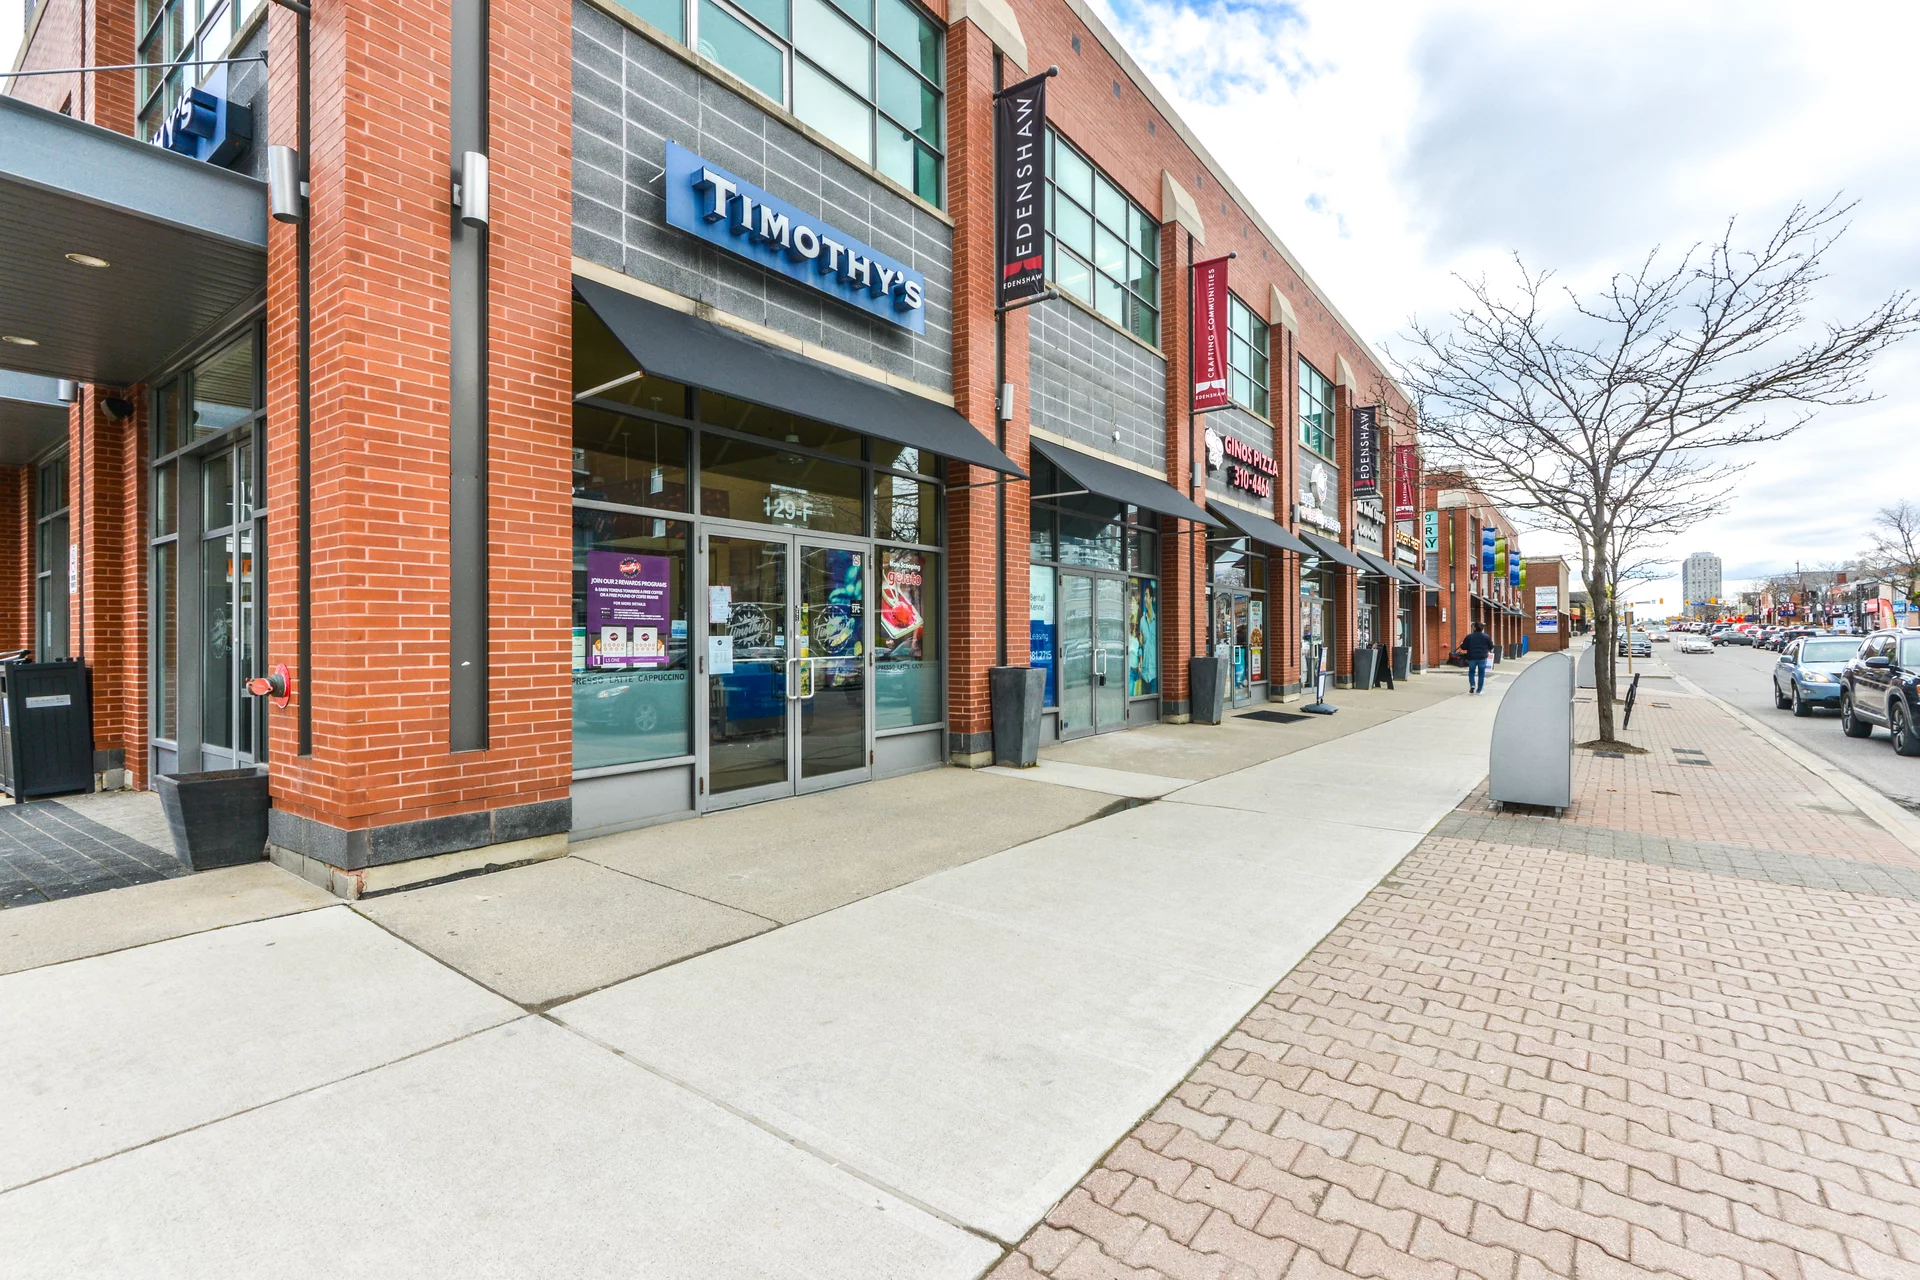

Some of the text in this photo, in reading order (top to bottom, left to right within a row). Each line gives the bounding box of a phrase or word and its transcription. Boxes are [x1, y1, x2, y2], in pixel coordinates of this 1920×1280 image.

[1016, 98, 1033, 256] EDENSHAW
[700, 165, 922, 310] TIMOTHY'S
[1003, 273, 1042, 290] EDENSHAW
[1195, 391, 1226, 401] EDENSHAW
[1224, 435, 1279, 477] GINOS PIZZA
[1360, 412, 1370, 479] EDENSHAW
[1234, 466, 1270, 498] 310-4466
[763, 496, 814, 522] 129-F
[888, 570, 922, 586] gelato
[609, 675, 634, 684] LATTE
[638, 673, 685, 682] CAPPUCCINO
